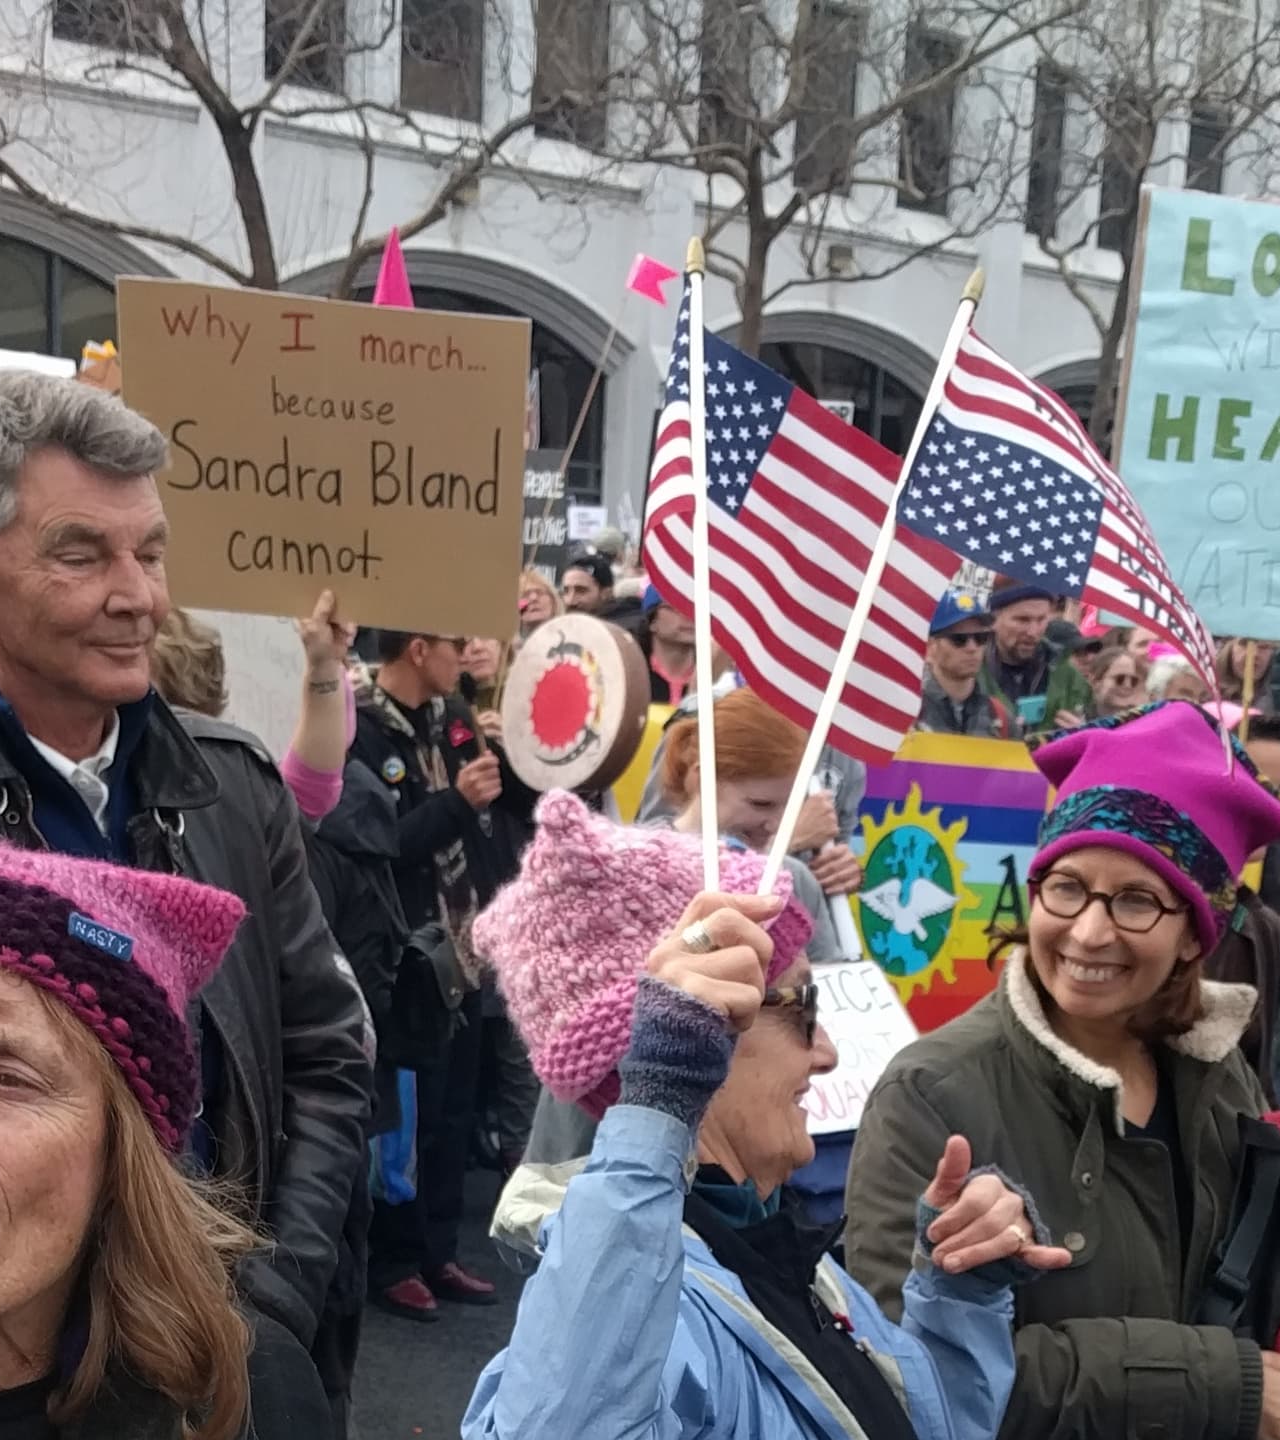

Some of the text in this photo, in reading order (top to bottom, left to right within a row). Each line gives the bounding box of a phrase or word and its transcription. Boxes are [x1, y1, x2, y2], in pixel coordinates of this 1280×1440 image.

[279, 312, 317, 353] I
[270, 375, 397, 426] because
[166, 418, 502, 518] Sandra Bland
[75, 920, 129, 955] NASTY
